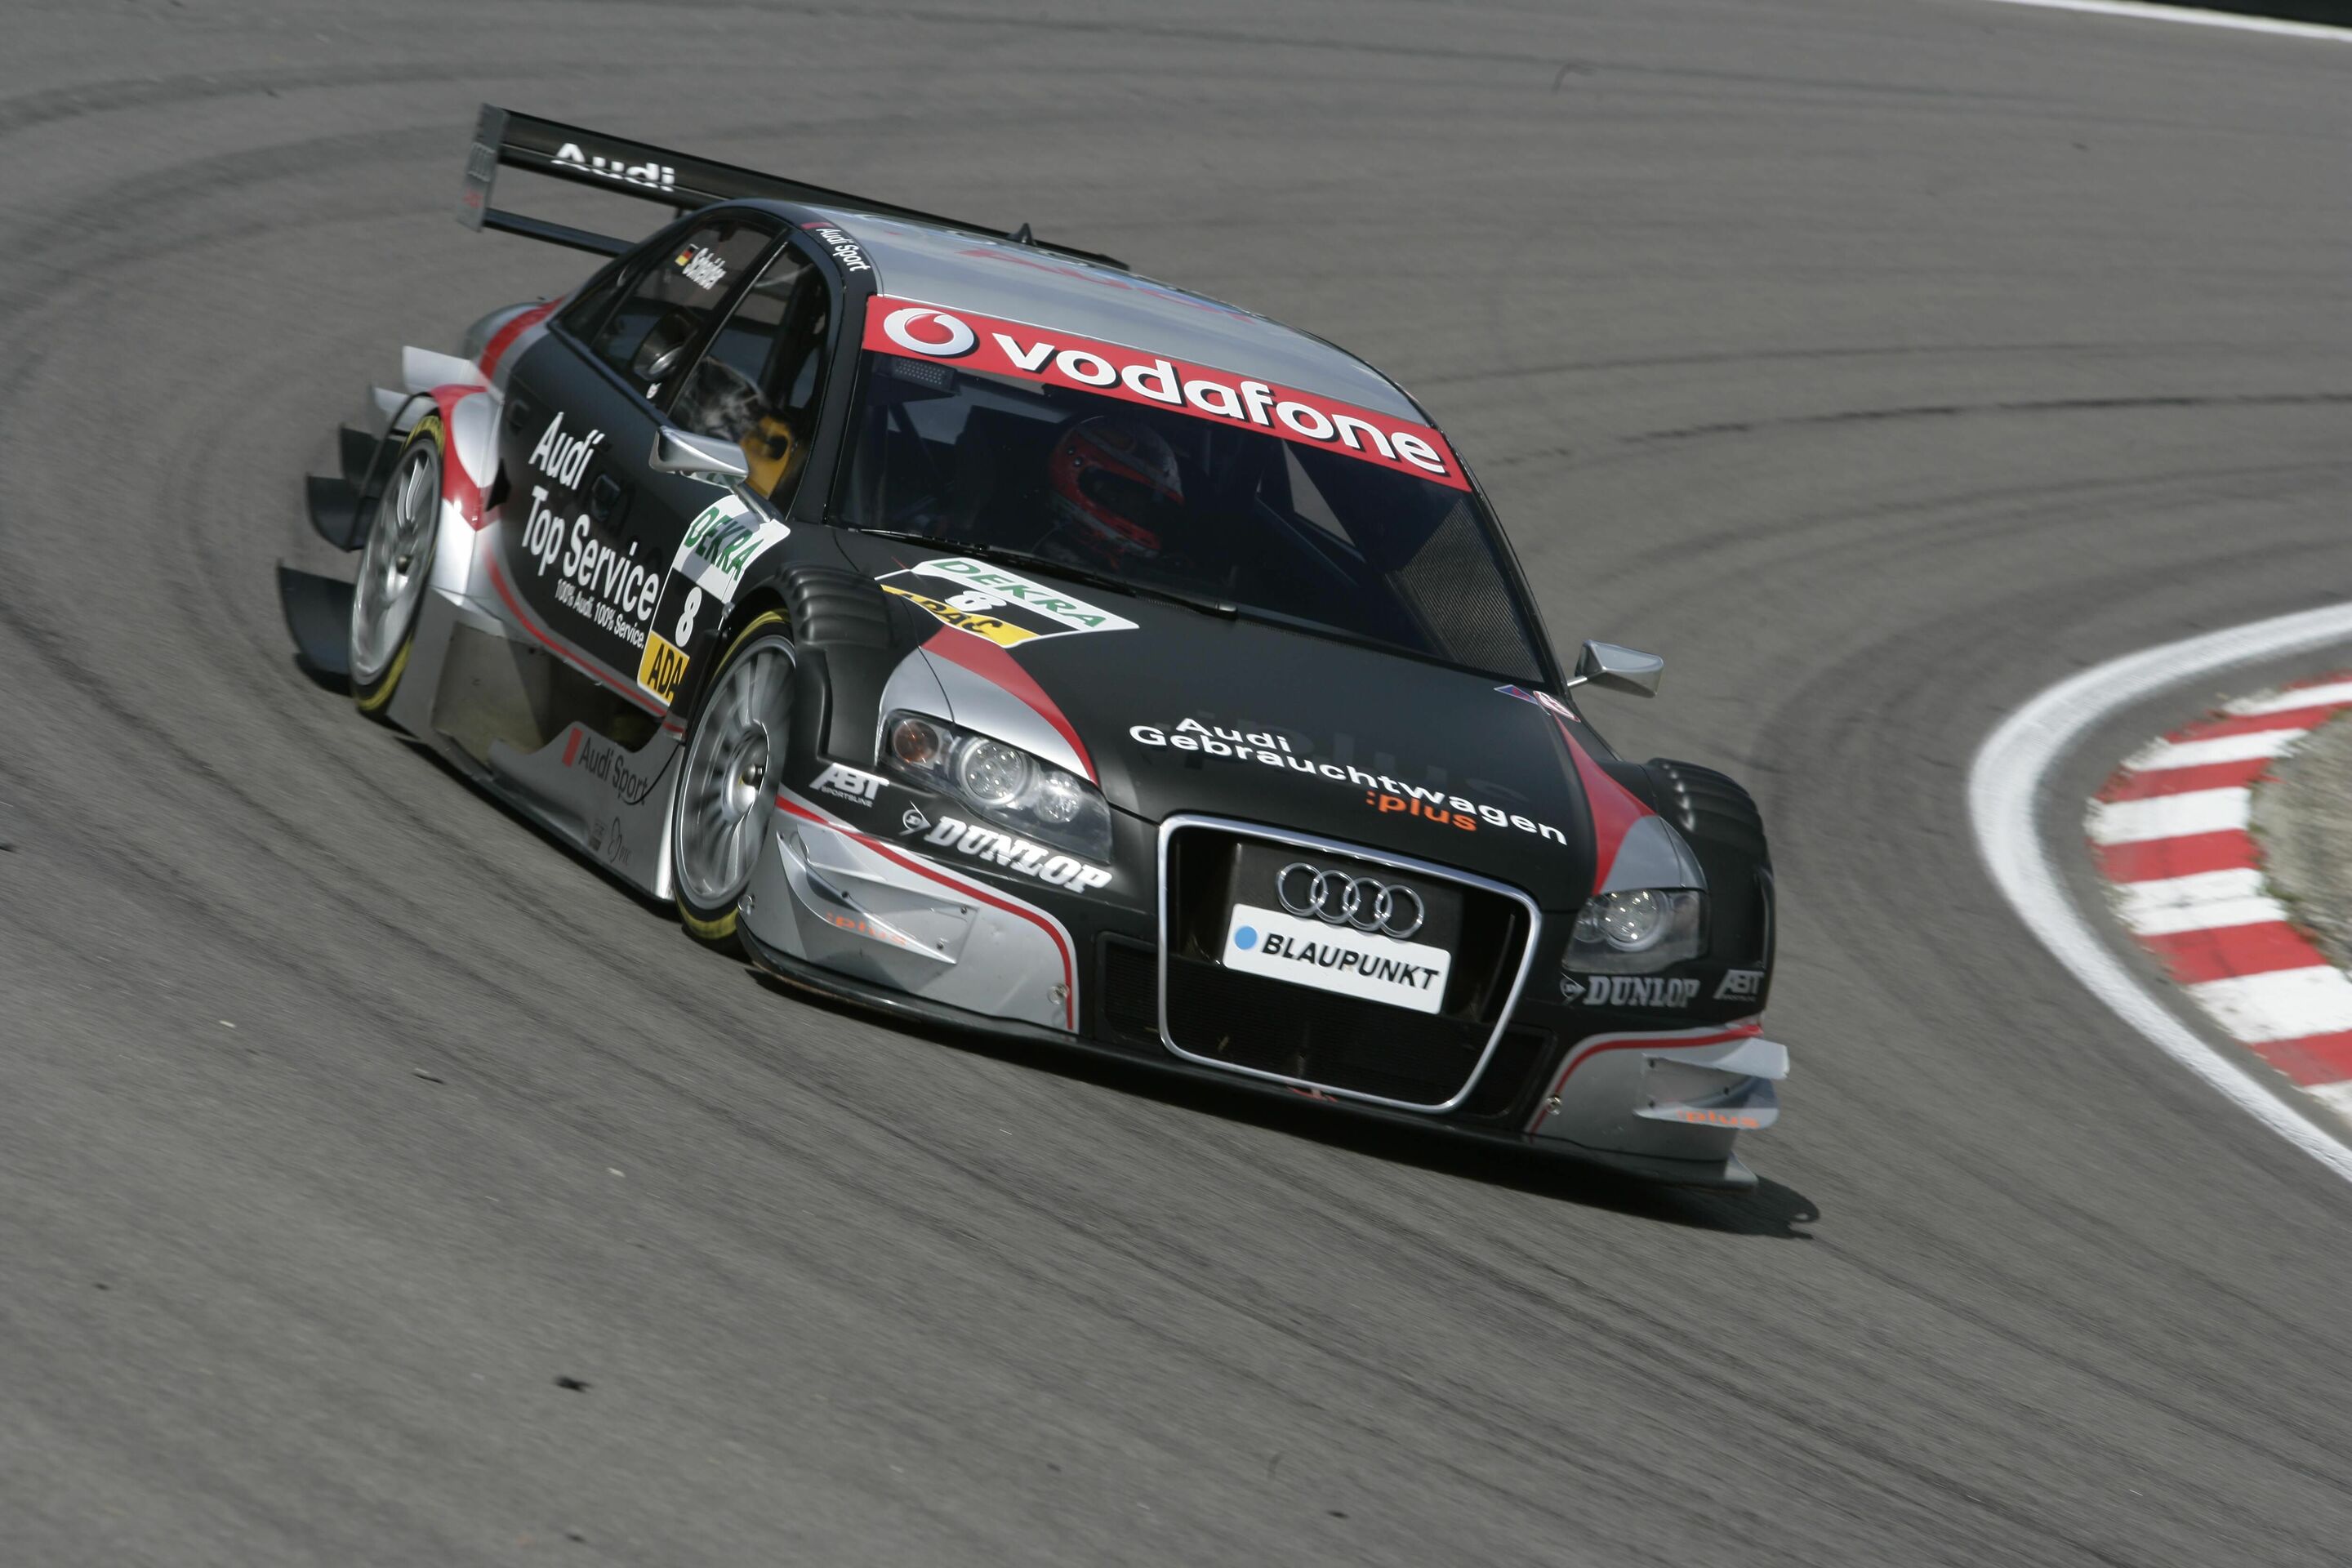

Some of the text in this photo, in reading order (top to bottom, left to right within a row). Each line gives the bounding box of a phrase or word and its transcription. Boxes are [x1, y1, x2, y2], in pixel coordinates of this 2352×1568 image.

[551, 143, 675, 192] Audi
[816, 229, 871, 272] Audi Sport
[992, 332, 1447, 475] vodafone
[529, 412, 605, 490] Audi
[522, 486, 660, 621] Top Service
[684, 506, 766, 581] DEKRA
[675, 586, 702, 648] 8
[900, 593, 1003, 635] DAC
[929, 560, 1107, 629] DEKRA
[944, 590, 1008, 612] 8
[594, 602, 617, 631] 100%
[614, 613, 644, 649] Service.
[1175, 718, 1292, 753] Audi
[578, 737, 648, 806] Audi Sport
[808, 762, 890, 800] ABT
[1129, 725, 1567, 846] Gebrauchtwagen
[924, 815, 1112, 893] DUNLOP
[1262, 933, 1441, 991] BLAUPUNKT
[1713, 969, 1765, 1000] ABT
[1582, 975, 1701, 1009] DUNLOP
